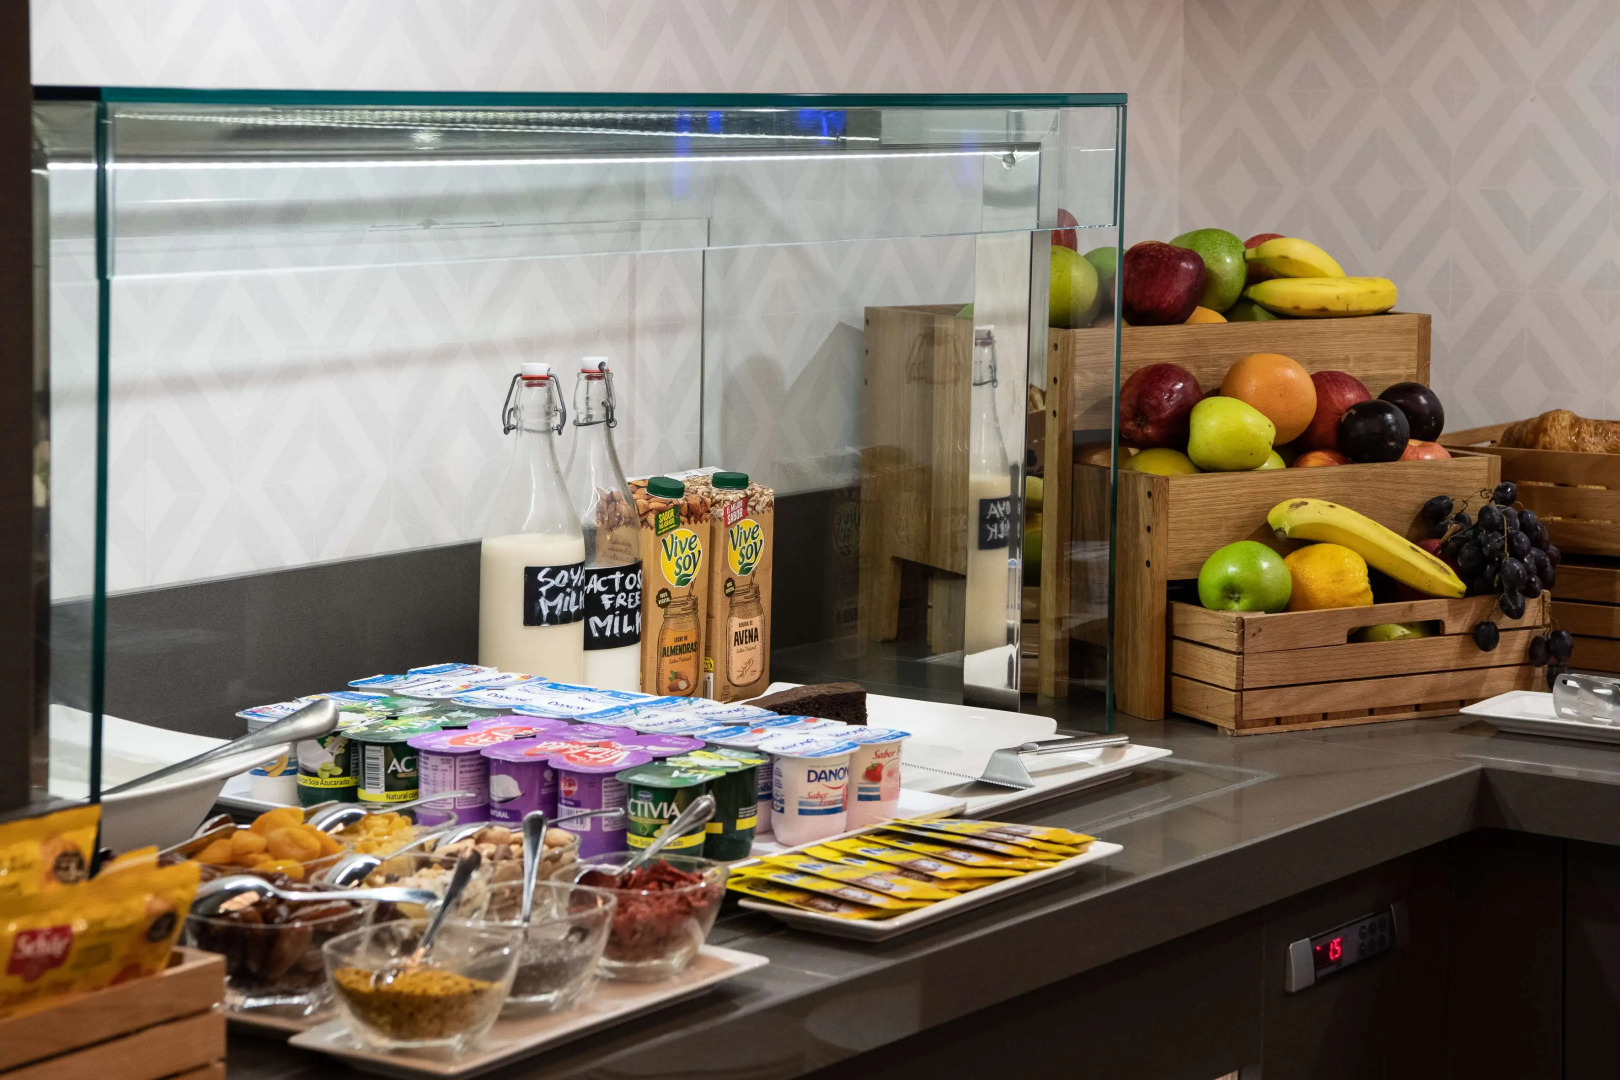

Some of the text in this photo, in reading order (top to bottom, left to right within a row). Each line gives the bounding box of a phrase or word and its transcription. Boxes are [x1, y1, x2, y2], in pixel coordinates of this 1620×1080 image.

[661, 533, 698, 562] Vive
[729, 523, 760, 552] Vive
[674, 549, 702, 577] soy
[737, 539, 763, 566] soy
[733, 627, 759, 647] AVENA
[662, 641, 698, 657] ALMENDRAS
[319, 777, 350, 786] Azucarado
[386, 792, 408, 801] Natural
